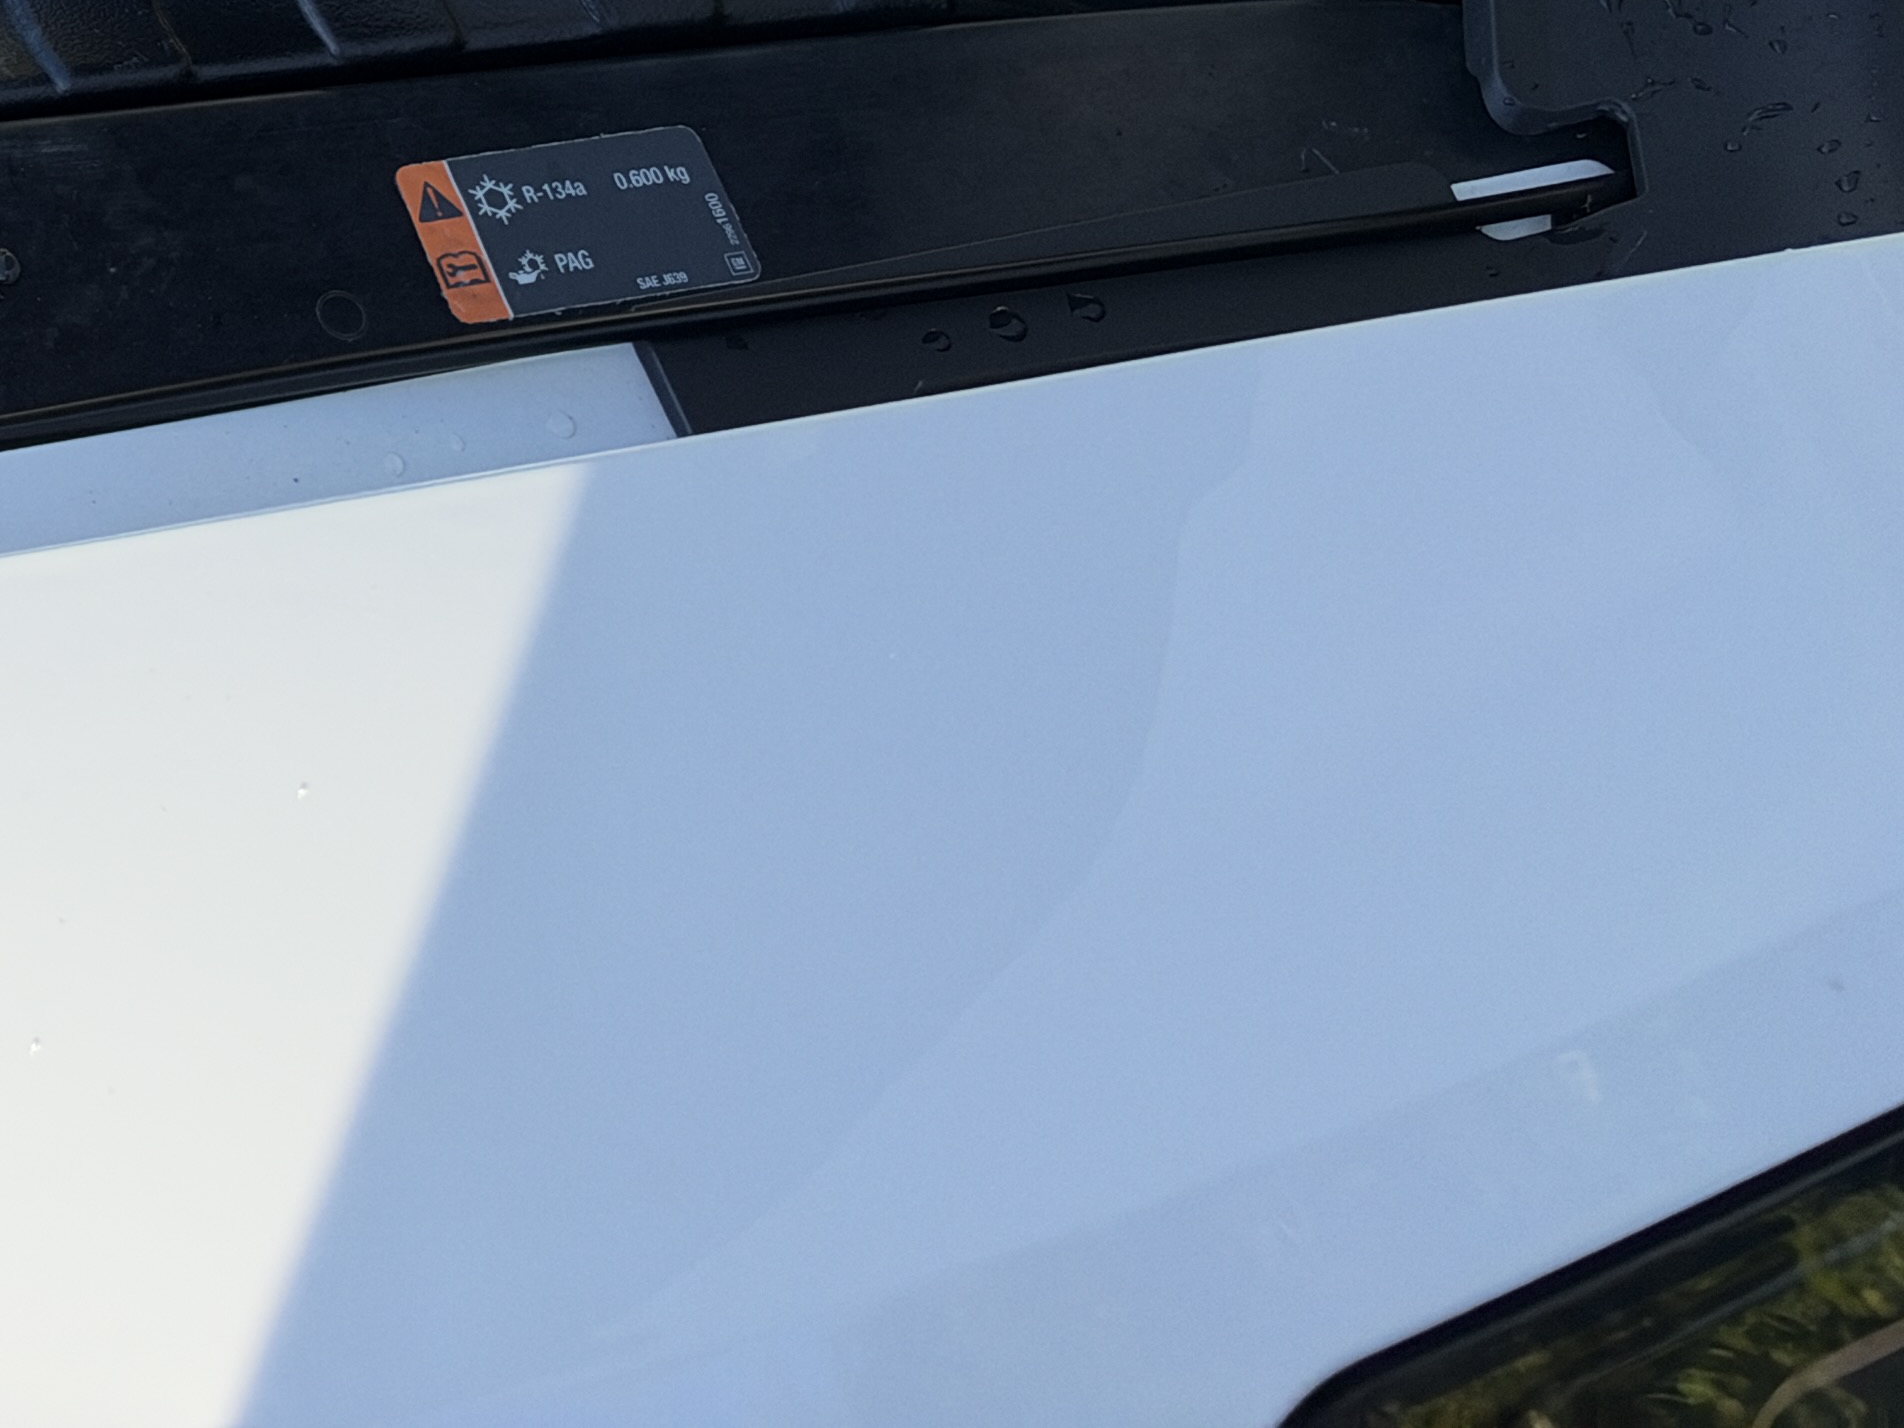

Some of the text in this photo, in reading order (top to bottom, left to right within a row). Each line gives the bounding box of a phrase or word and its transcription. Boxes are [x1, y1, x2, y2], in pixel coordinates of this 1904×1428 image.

[522, 164, 691, 205] R-134a 0.600 kg
[554, 249, 596, 275] PAG
[636, 275, 660, 291] SAE
